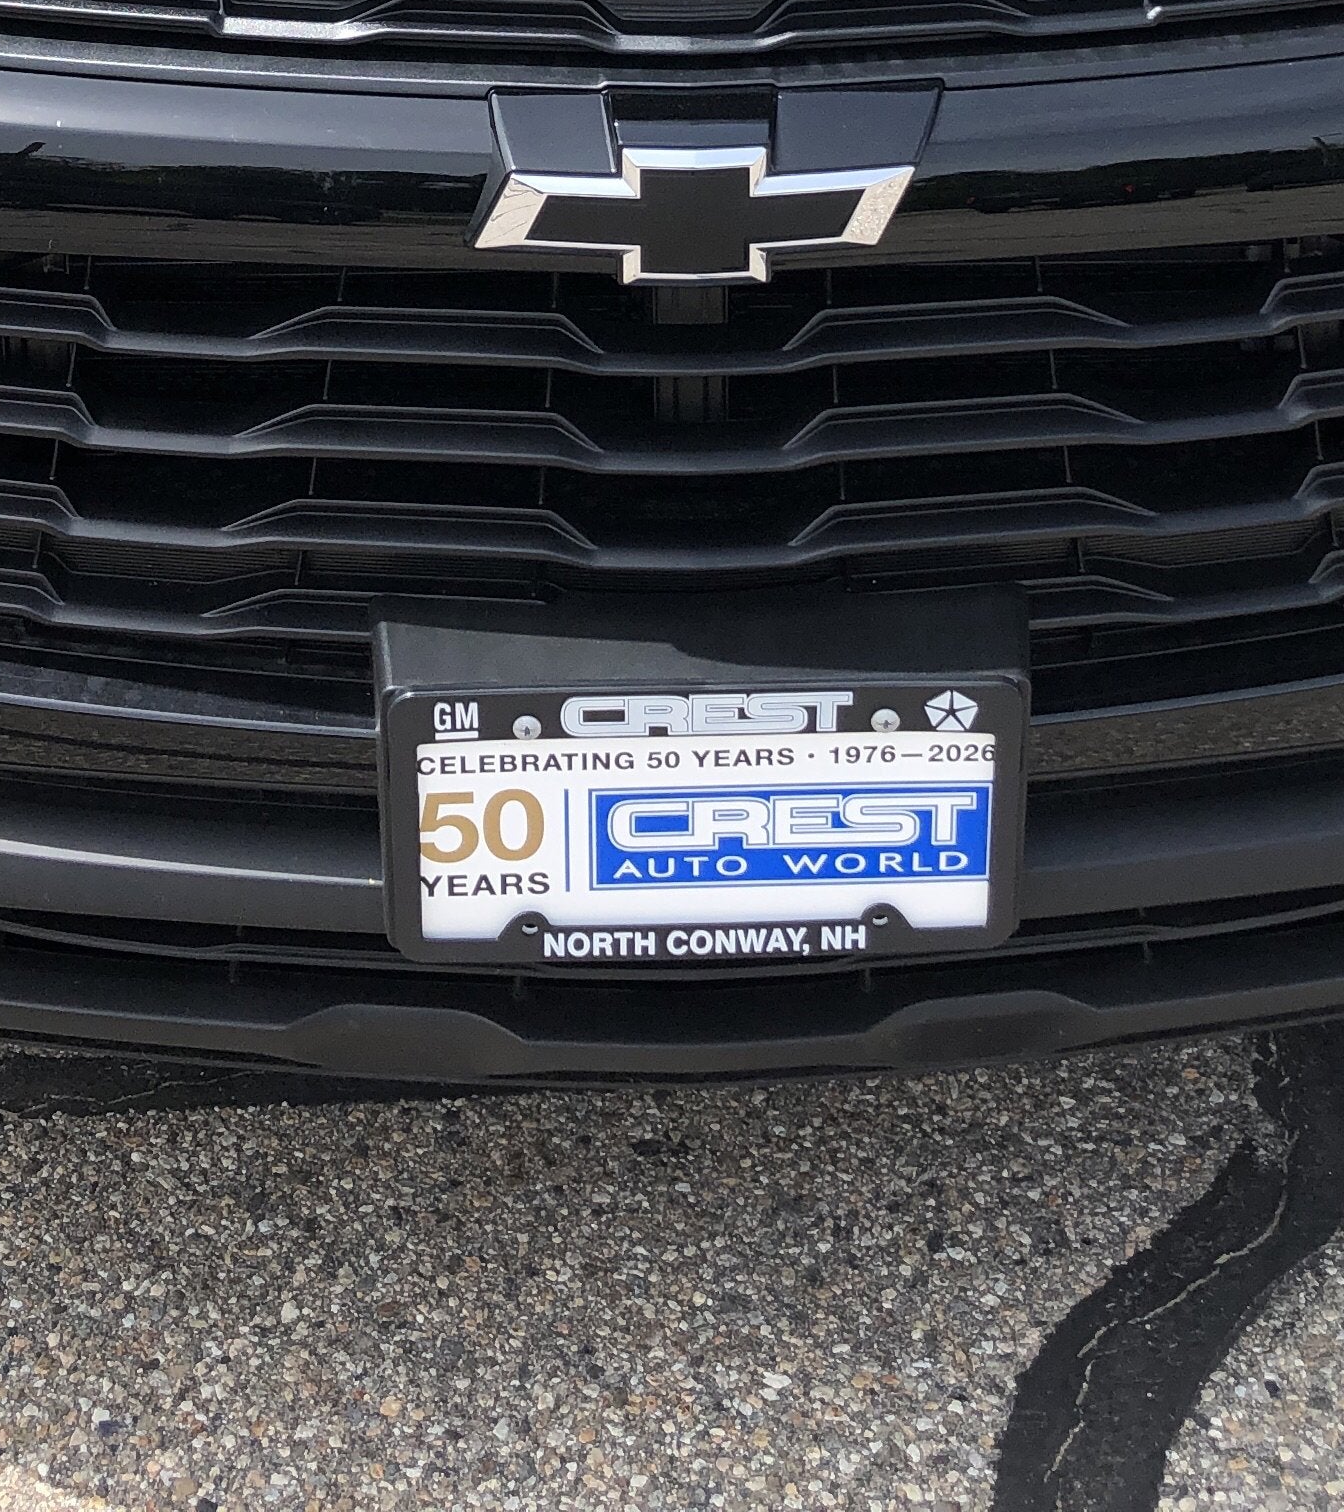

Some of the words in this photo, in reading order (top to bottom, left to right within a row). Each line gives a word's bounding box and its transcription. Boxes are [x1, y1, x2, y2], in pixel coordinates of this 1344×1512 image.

[433, 701, 479, 731] GM
[560, 691, 854, 737] CREST
[417, 751, 634, 776] CELEBRATING
[646, 750, 681, 769] 50
[692, 747, 795, 768] YEARS
[420, 789, 544, 863] 50
[607, 791, 977, 853] CREST
[612, 855, 748, 879] AUTO
[783, 851, 969, 874] WORLD
[420, 872, 550, 897] YEARS
[543, 931, 656, 958] NORTH
[666, 926, 810, 956] CONWAY,
[820, 925, 866, 951] NH
